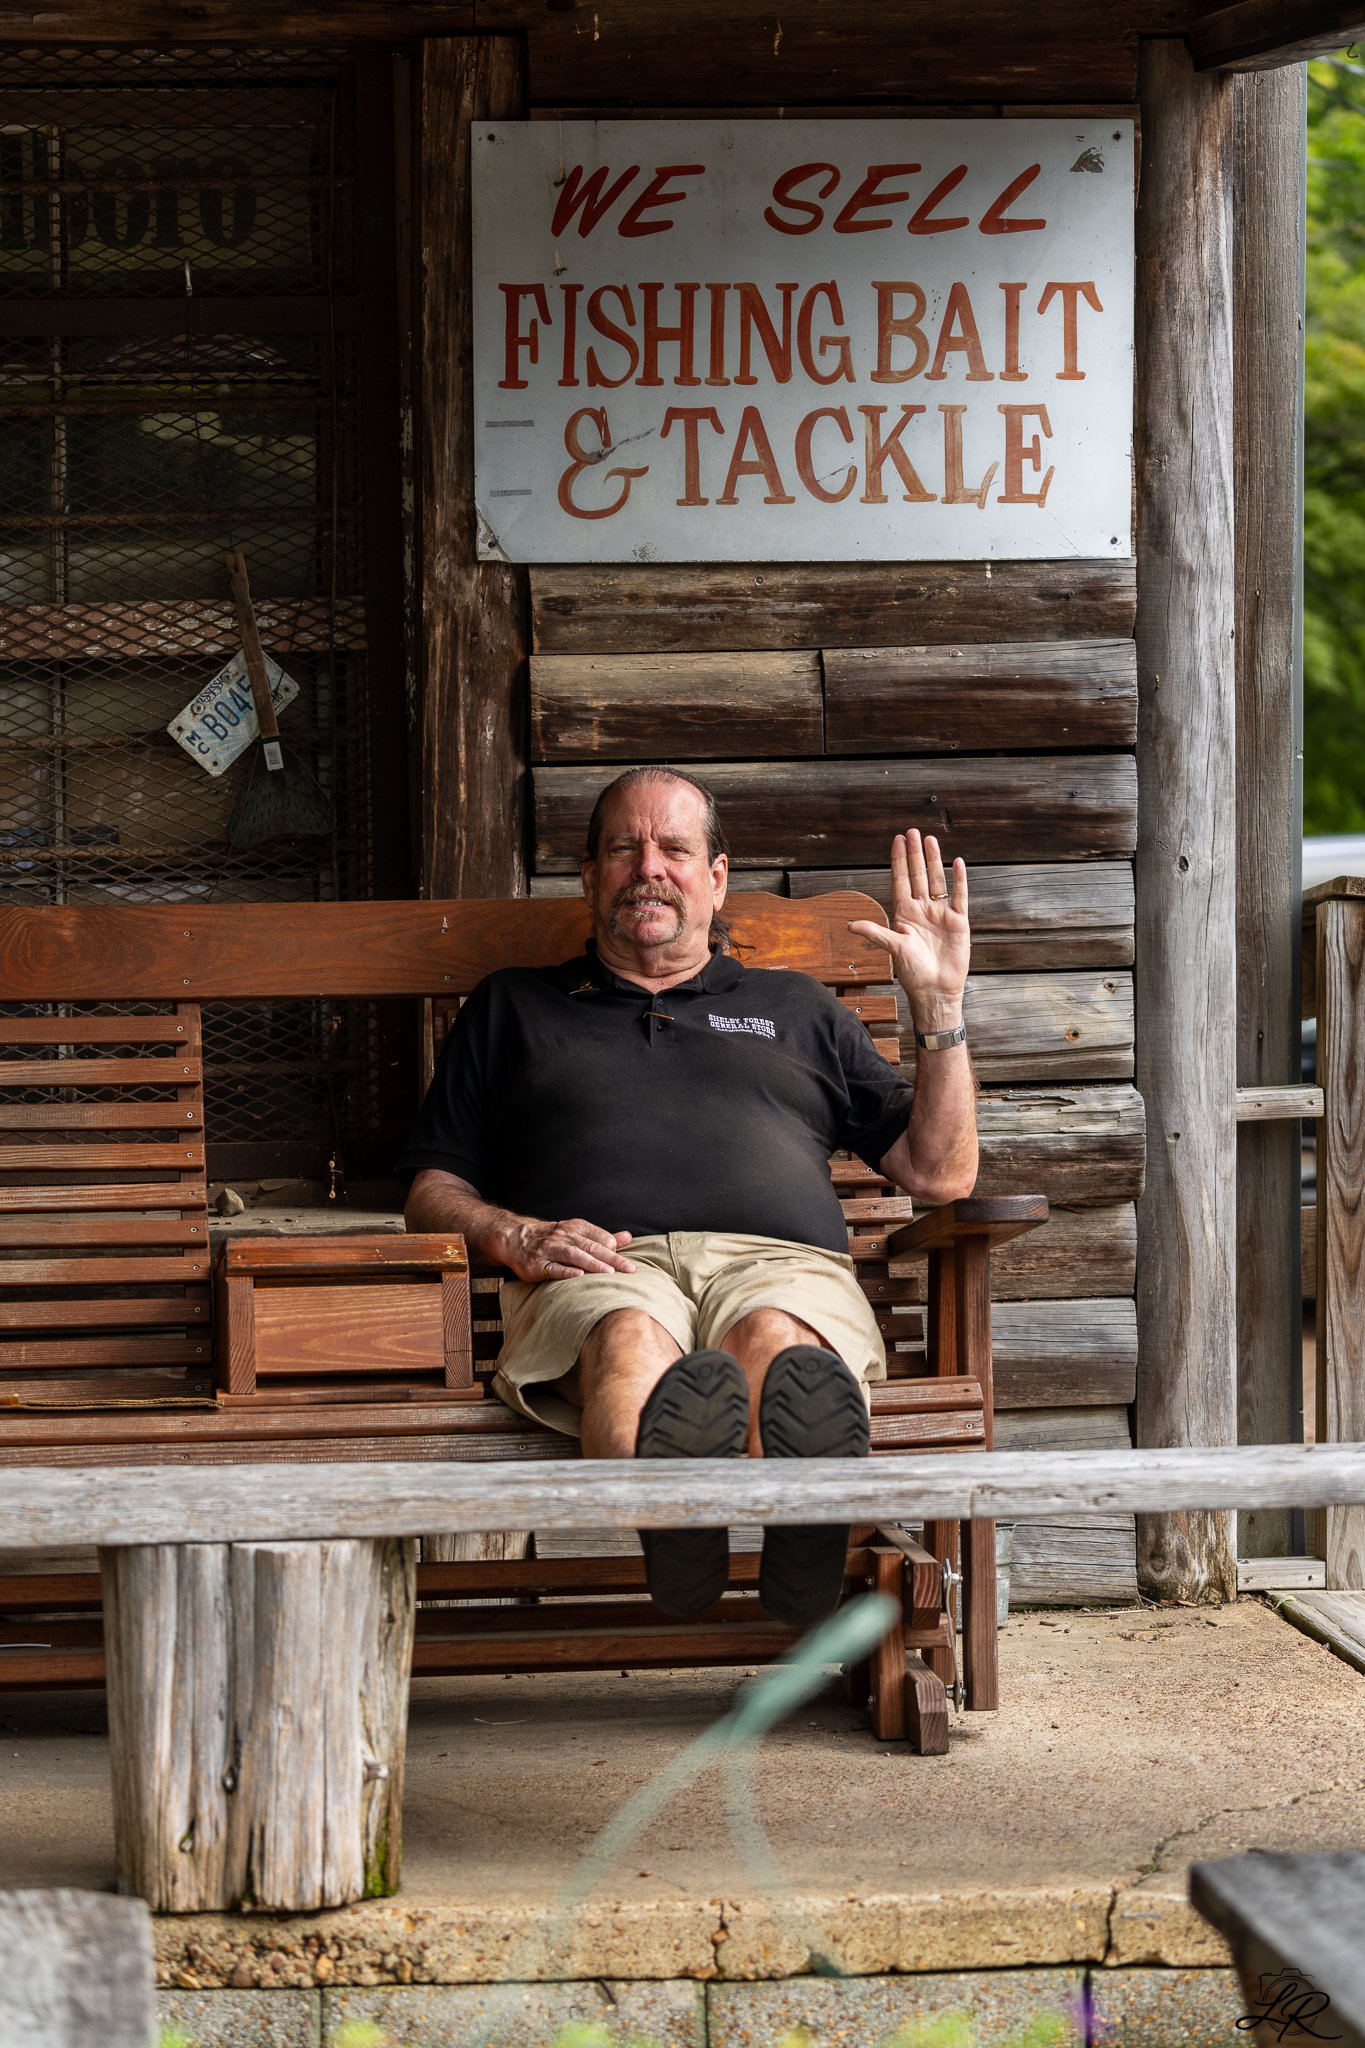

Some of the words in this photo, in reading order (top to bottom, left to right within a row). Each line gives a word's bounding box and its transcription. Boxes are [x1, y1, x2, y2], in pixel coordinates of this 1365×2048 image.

[550, 164, 706, 239] WE
[763, 161, 1047, 236] SELL
[497, 279, 857, 390] FISHING
[870, 279, 1104, 384] BAIT
[556, 405, 649, 520] &
[660, 403, 1056, 510] TACKLE
[708, 1013, 740, 1024] SHELBY
[710, 1021, 750, 1029] GENERAL
[751, 1023, 776, 1037] STORE
